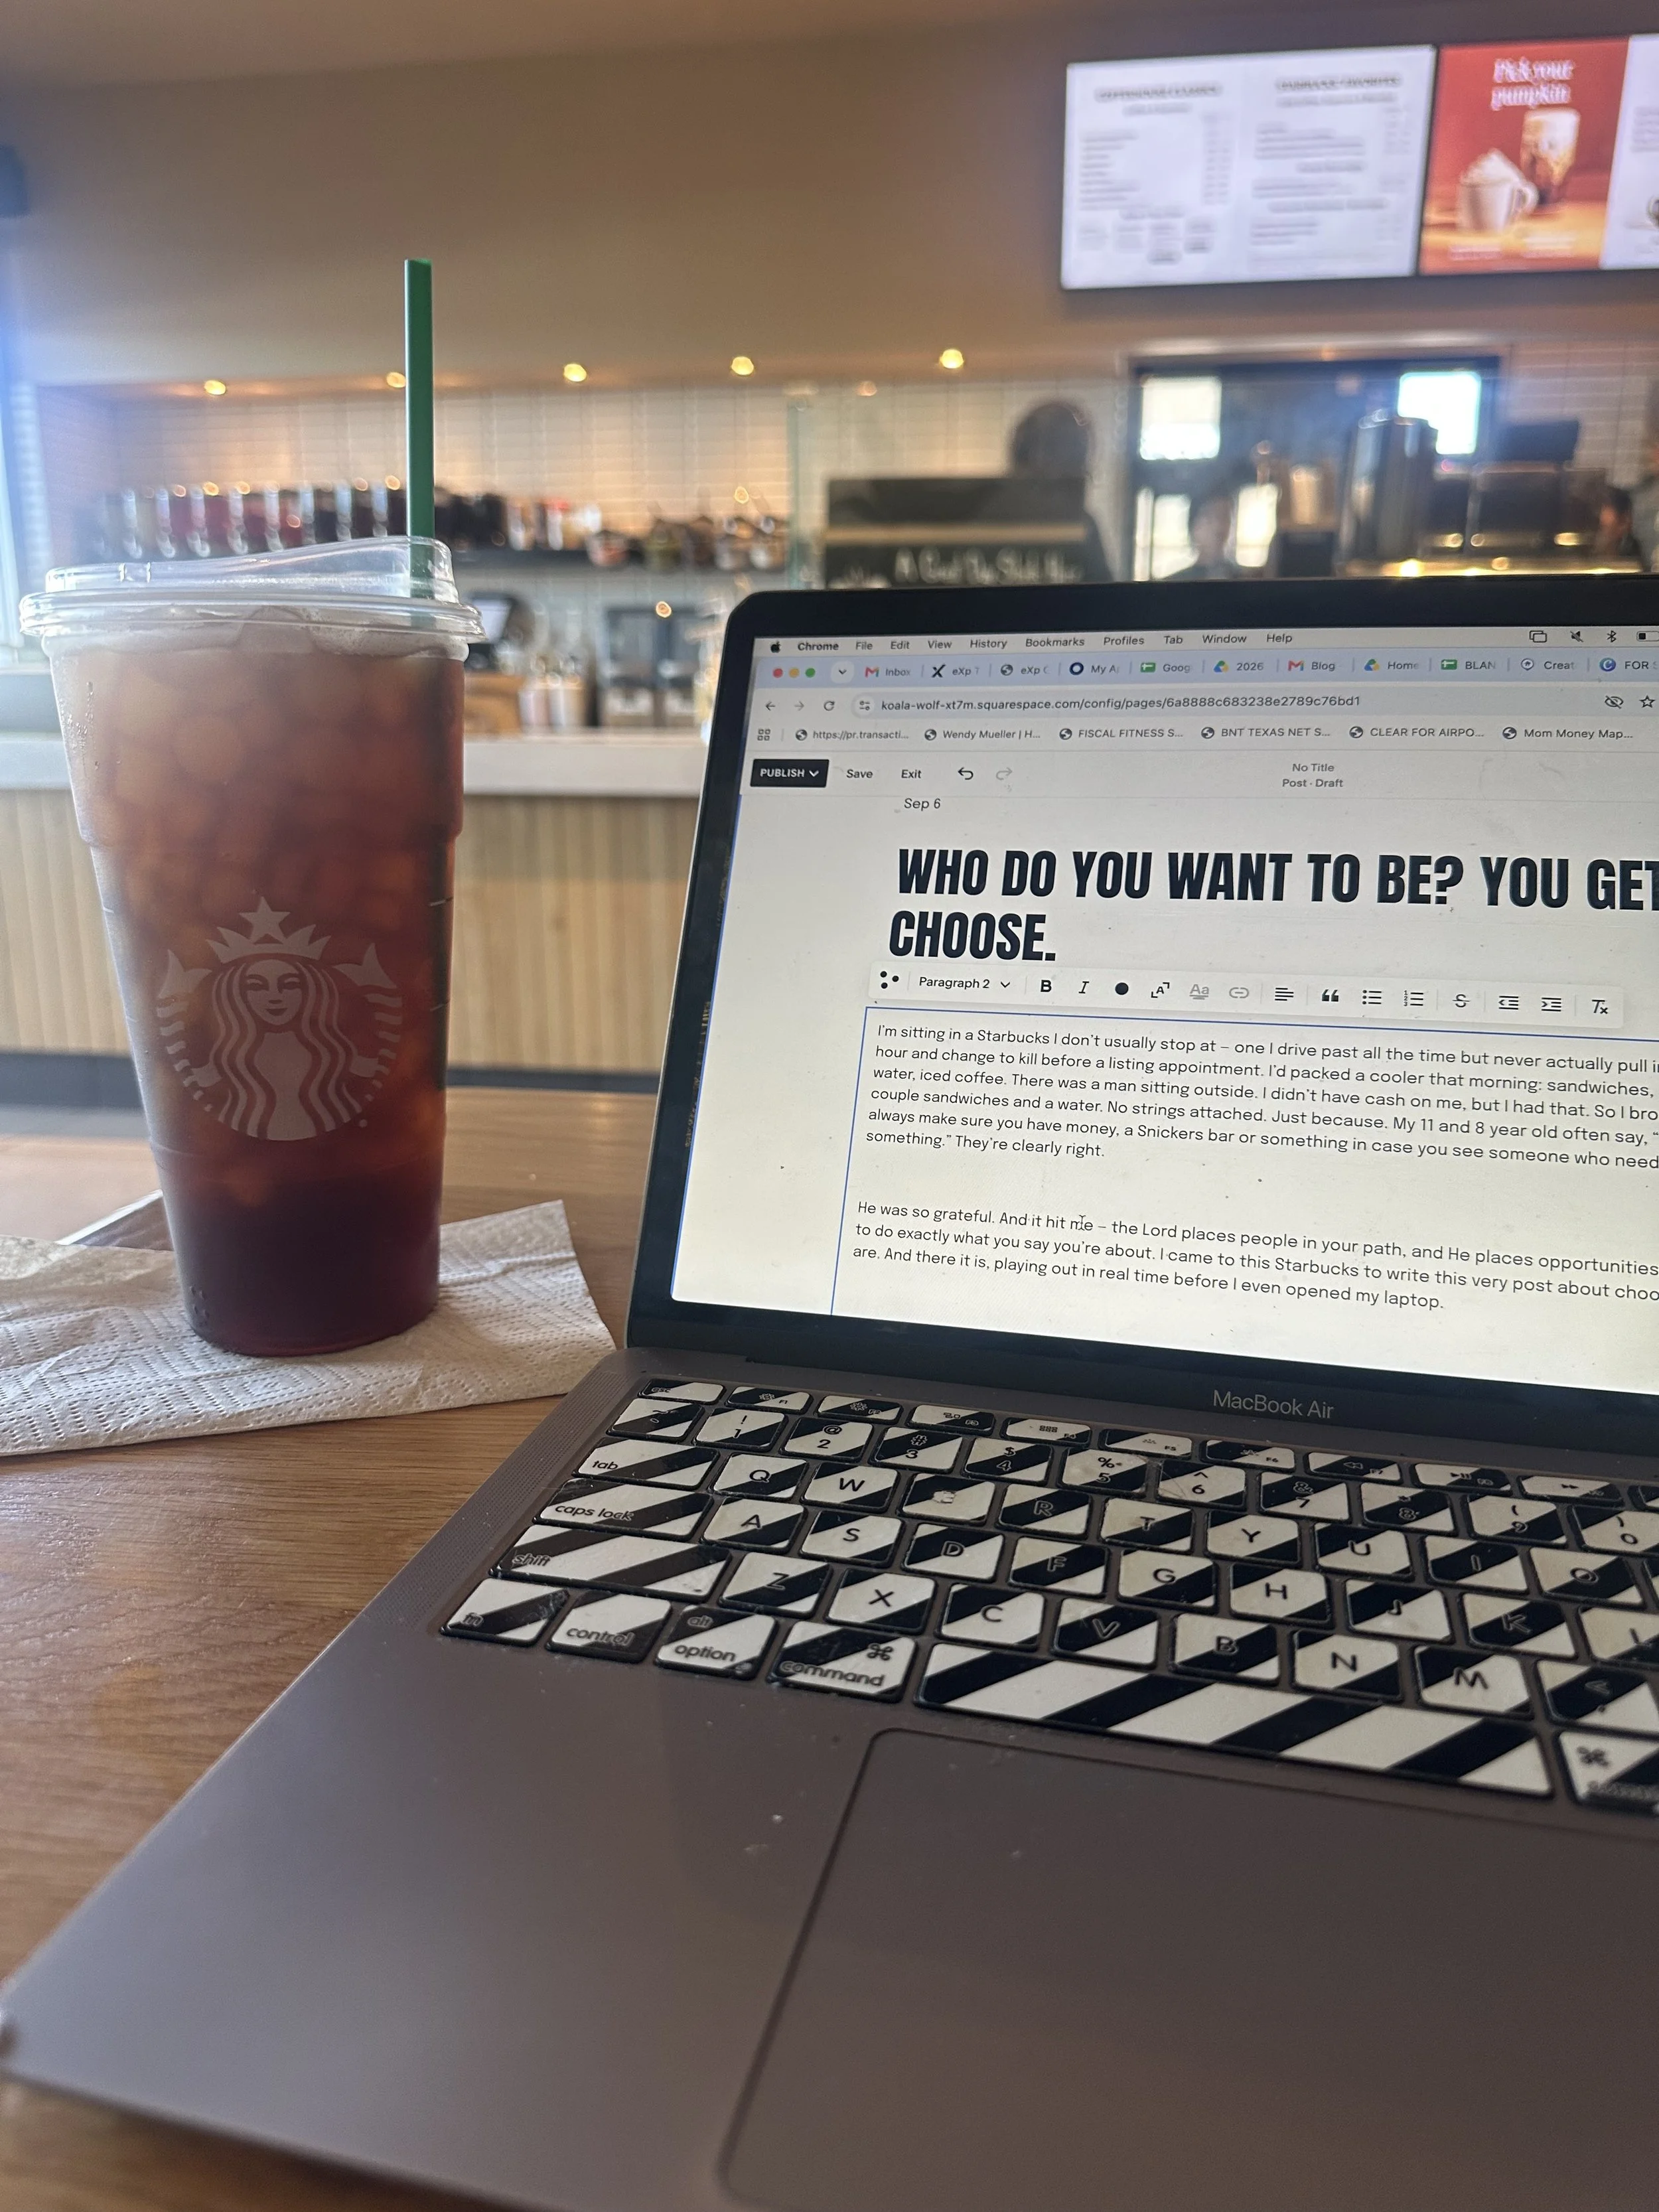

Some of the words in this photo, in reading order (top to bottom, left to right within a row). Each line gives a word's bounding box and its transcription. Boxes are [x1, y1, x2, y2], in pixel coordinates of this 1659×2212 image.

[798, 642, 839, 652] Chrome
[855, 641, 873, 651] File
[891, 640, 910, 650] Edit
[928, 640, 952, 650] View
[970, 638, 1007, 651] History
[1025, 637, 1085, 648] Bookmarks
[1103, 635, 1145, 646] Profiles
[1164, 635, 1183, 644] Tab
[1202, 634, 1247, 644] Window
[1266, 633, 1293, 644] Help
[885, 667, 910, 677] Inbox
[952, 667, 972, 677] eXp
[1021, 666, 1040, 676] eXp
[1090, 665, 1107, 676] My
[1162, 663, 1190, 674] Goog
[1236, 662, 1264, 672] 2026
[1311, 661, 1336, 672] Blog
[1387, 660, 1419, 670] Home
[1465, 660, 1496, 670] BLAN
[1624, 661, 1650, 670] FOR
[942, 729, 975, 742] Wendy
[979, 729, 1016, 740] Mueller
[1078, 729, 1116, 738] FISCAL
[1119, 728, 1165, 737] FITNESS
[1221, 728, 1245, 737] BNT
[1248, 727, 1285, 737] TEXAS
[1287, 727, 1311, 737] NET
[1370, 727, 1408, 737] CLEAR
[1411, 727, 1435, 737] FOR
[1438, 727, 1484, 737] AIRPO...
[1524, 729, 1553, 738] Mom
[1555, 729, 1595, 740] Money
[1598, 729, 1634, 741] Map...
[760, 769, 805, 778] PUBLISH
[846, 769, 873, 779] Save
[901, 769, 922, 779] Exit
[1292, 763, 1308, 773] No
[1311, 763, 1334, 773] Title
[1282, 778, 1308, 788] Post
[1315, 778, 1344, 788] Draft
[904, 798, 930, 812] Sep
[933, 798, 941, 809] 6
[899, 849, 989, 895] WHO
[1001, 850, 1056, 897] DO
[1072, 851, 1152, 899] YOU
[1168, 853, 1292, 901] WANT
[1307, 854, 1360, 903] TO
[1377, 855, 1464, 905] BE?
[1480, 857, 1569, 909] YOU
[1587, 859, 1659, 911] GET
[889, 910, 1056, 962] CHOOSE.
[918, 976, 979, 990] Paragraph
[983, 979, 990, 989] 2
[875, 1045, 908, 1059] hour
[911, 1047, 938, 1060] and
[942, 1049, 995, 1066] change
[999, 1052, 1015, 1064] to
[1019, 1051, 1037, 1065] kill
[1041, 1053, 1092, 1068] before
[1096, 1059, 1105, 1069] a
[1108, 1056, 1155, 1074] listing
[1159, 1061, 1264, 1076] appointment.
[1269, 1064, 1286, 1078] I'd
[1290, 1066, 1350, 1081] packed
[1355, 1072, 1365, 1082] a
[1369, 1070, 1425, 1084] cooler
[1428, 1072, 1465, 1086] that
[1469, 1076, 1542, 1094] morning:
[1547, 1079, 1654, 1098] sandwiches,
[868, 1108, 915, 1125] always
[918, 1112, 957, 1126] make
[960, 1116, 994, 1128] sure
[995, 1119, 1023, 1132] you
[1027, 1117, 1062, 1132] have
[1066, 1123, 1119, 1138] money,
[1124, 1126, 1133, 1136] a
[1137, 1124, 1204, 1141] Snickers
[1208, 1128, 1235, 1142] bar
[1238, 1134, 1257, 1143] or
[1260, 1134, 1348, 1153] something
[1352, 1137, 1367, 1151] in
[1372, 1142, 1413, 1153] case
[1417, 1144, 1447, 1157] you
[1452, 1147, 1484, 1158] see
[1488, 1149, 1569, 1163] someone
[1574, 1151, 1610, 1166] who
[955, 1135, 1008, 1152] They're
[1012, 1138, 1062, 1157] clearly
[1066, 1142, 1104, 1159] right.
[853, 1248, 880, 1259] are.
[884, 1247, 912, 1262] And
[915, 1250, 956, 1265] there
[960, 1254, 971, 1267] it
[974, 1254, 989, 1270] is,
[994, 1256, 1048, 1277] playing
[1051, 1264, 1078, 1276] out
[1082, 1264, 1095, 1278] in
[1100, 1267, 1129, 1281] real
[1133, 1269, 1169, 1284] time
[1174, 1271, 1228, 1290] before
[1241, 1282, 1281, 1294] even
[1285, 1286, 1351, 1301] opened
[1356, 1291, 1380, 1306] my
[1384, 1290, 1443, 1311] laptop.
[1212, 1389, 1303, 1416] MacBook
[1307, 1400, 1334, 1419] Air
[817, 1439, 831, 1449] 2
[904, 1449, 918, 1459] 3
[591, 1459, 618, 1471] tab
[997, 1460, 1012, 1471] 4
[749, 1469, 770, 1483] Q
[1098, 1471, 1112, 1483] 5
[839, 1477, 865, 1492] W
[1192, 1485, 1205, 1495] 6
[555, 1503, 594, 1517] caps
[597, 1505, 635, 1522] lock
[1034, 1501, 1054, 1517] R
[740, 1514, 762, 1528] A
[1139, 1516, 1156, 1531] T
[843, 1528, 861, 1542] S
[1241, 1528, 1262, 1544] Y
[941, 1542, 966, 1558] D
[512, 1552, 552, 1568] shift
[1046, 1556, 1067, 1572] F
[764, 1572, 787, 1590] Z
[1152, 1568, 1177, 1584] G
[1264, 1582, 1287, 1599] H
[868, 1588, 896, 1608] X
[981, 1605, 1003, 1623] C
[1092, 1619, 1121, 1639] V
[566, 1626, 634, 1647] control
[1214, 1636, 1240, 1655] B
[674, 1642, 737, 1664] option
[1331, 1652, 1358, 1672] N
[780, 1659, 886, 1688] command
[1453, 1668, 1490, 1690] M
